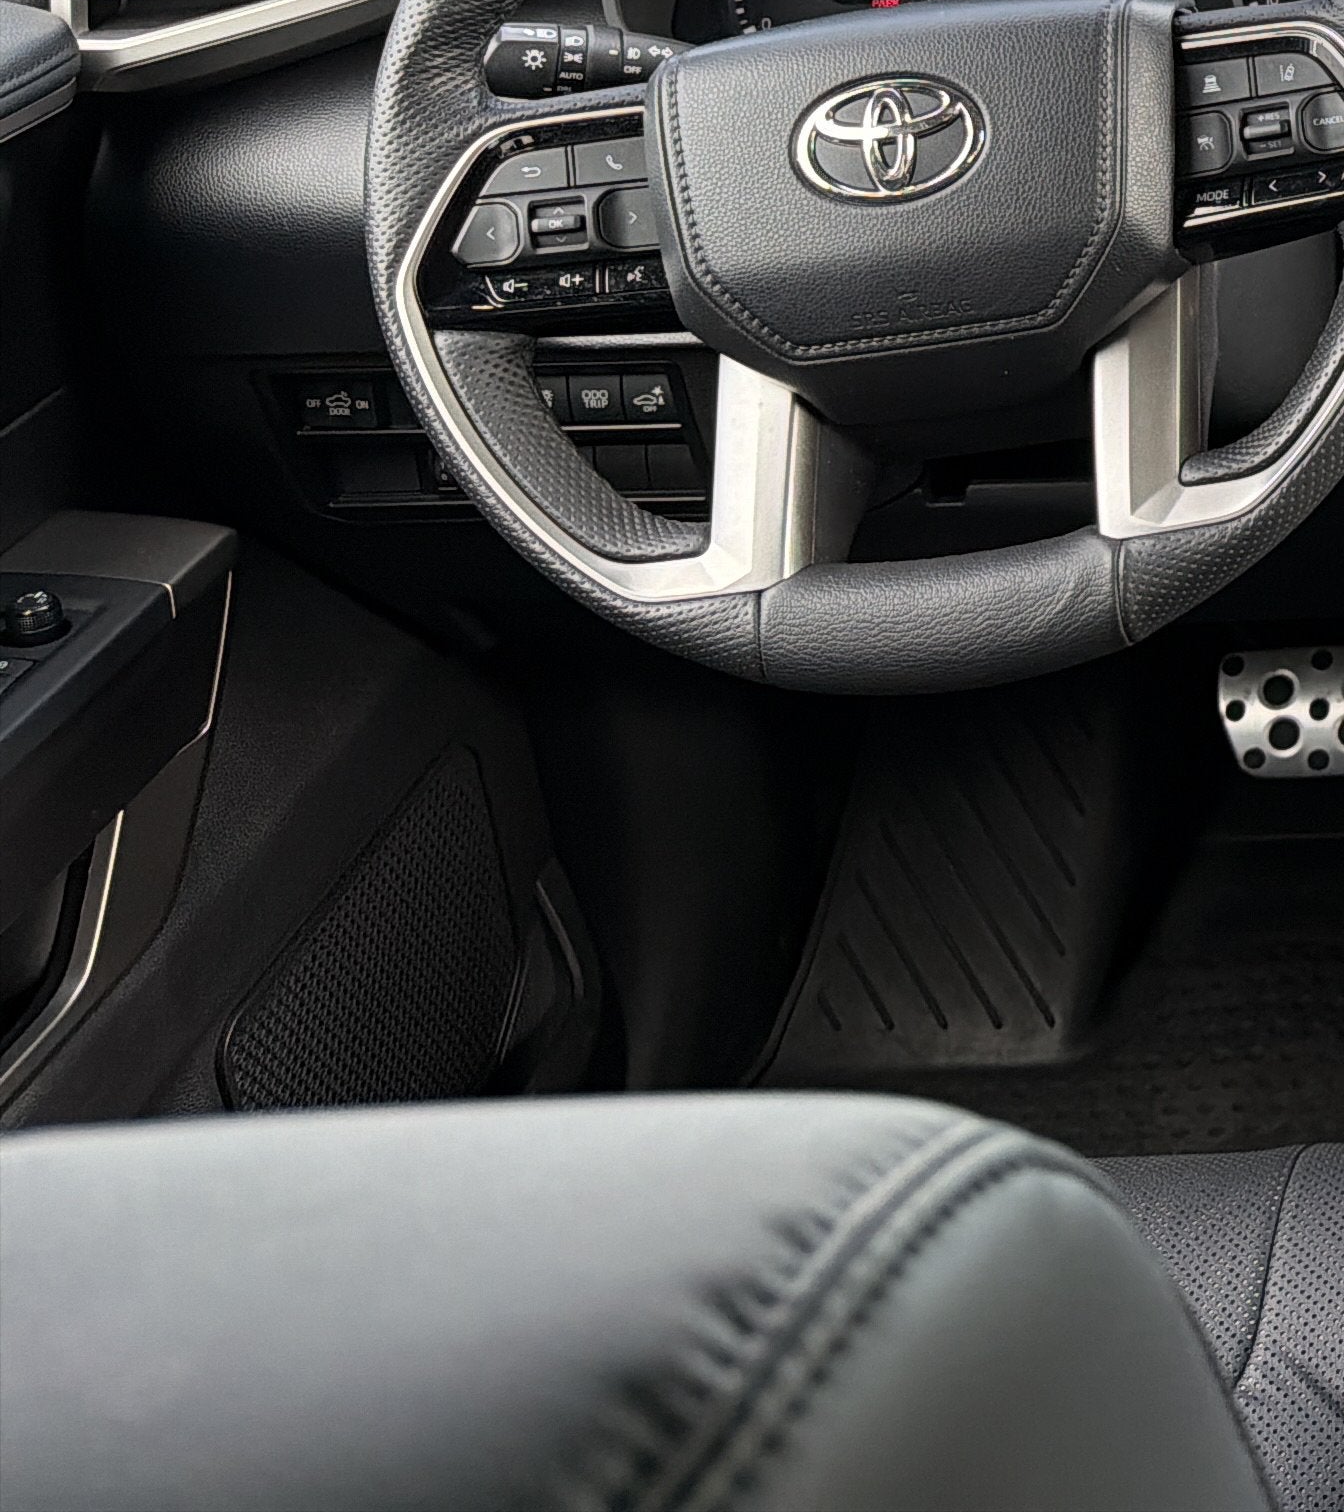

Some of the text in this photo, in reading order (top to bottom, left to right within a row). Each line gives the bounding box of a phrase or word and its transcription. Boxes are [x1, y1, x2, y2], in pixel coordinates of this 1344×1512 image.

[623, 65, 642, 75] OFF
[559, 71, 584, 81] AUTO
[1312, 115, 1344, 126] CANCEL
[1267, 141, 1283, 149] SET
[1196, 190, 1229, 202] MODE
[548, 219, 565, 230] OK
[581, 389, 609, 400] ODO
[306, 399, 321, 408] OFF
[355, 400, 369, 409] ON
[584, 399, 609, 409] TRIP
[329, 408, 351, 416] DOOR
